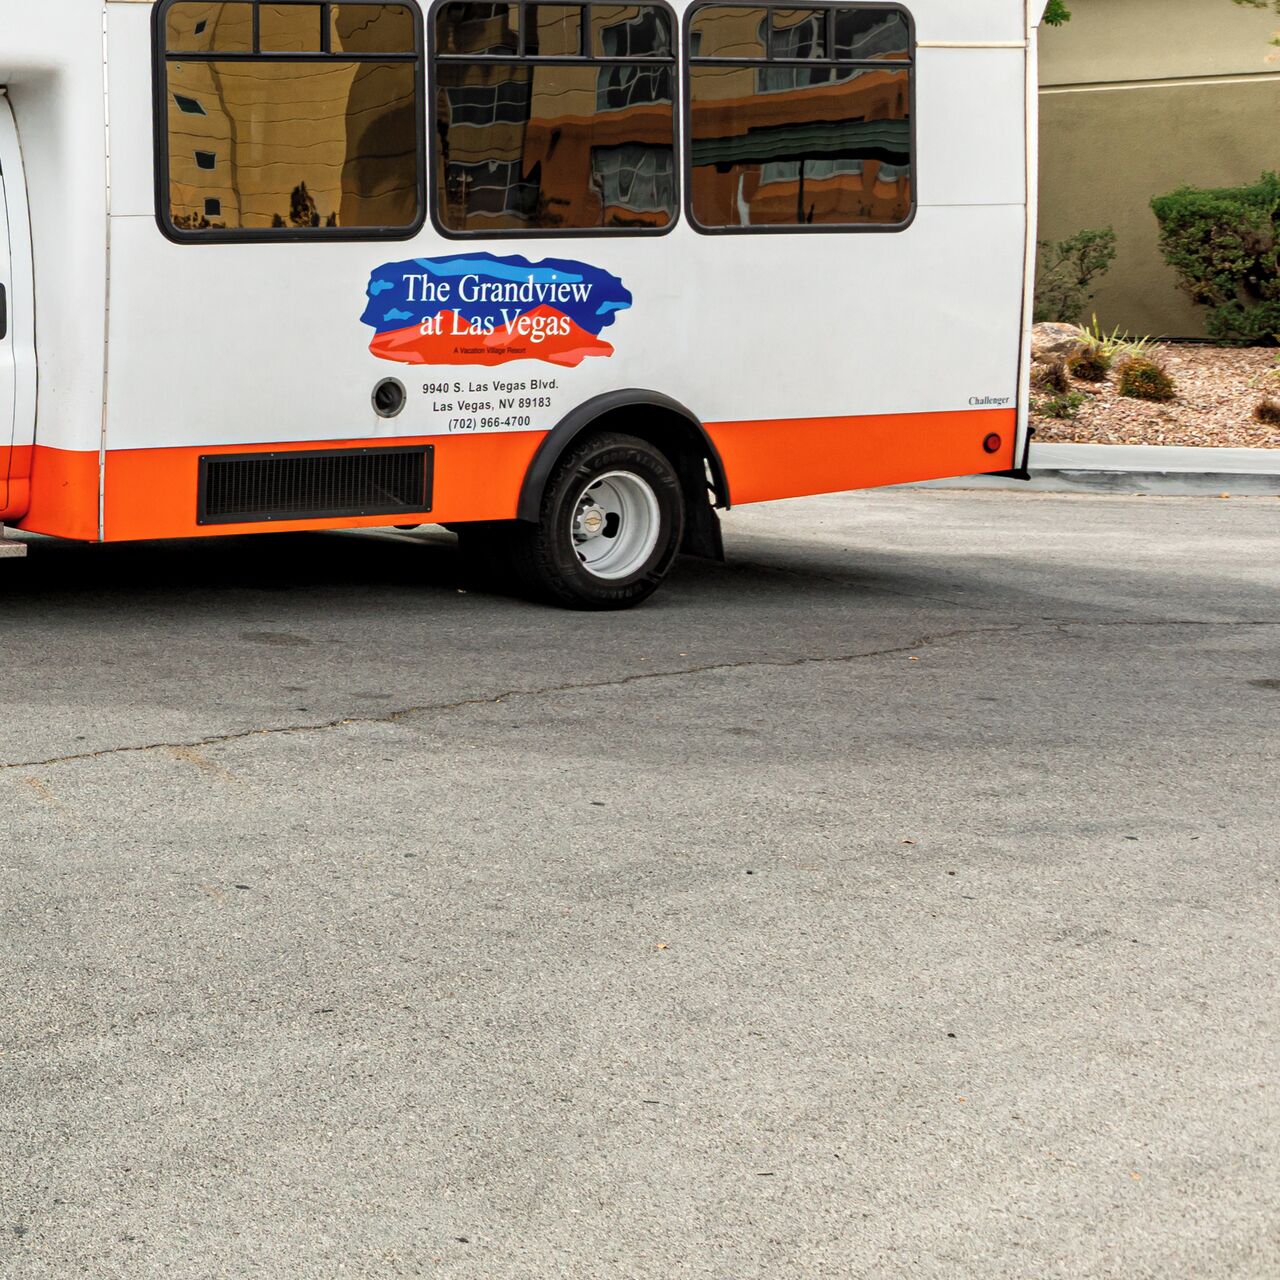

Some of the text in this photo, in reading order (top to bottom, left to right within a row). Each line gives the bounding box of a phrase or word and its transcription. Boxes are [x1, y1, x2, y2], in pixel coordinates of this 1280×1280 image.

[402, 273, 592, 303] The Grandview
[420, 308, 570, 343] at Las Vegas
[422, 379, 559, 394] 9940 S. Las Vegas Blvd.
[433, 397, 551, 413] Las Vegas, NV 89183
[968, 396, 1010, 405] Challenger
[448, 416, 531, 432] (702) 966-4700
